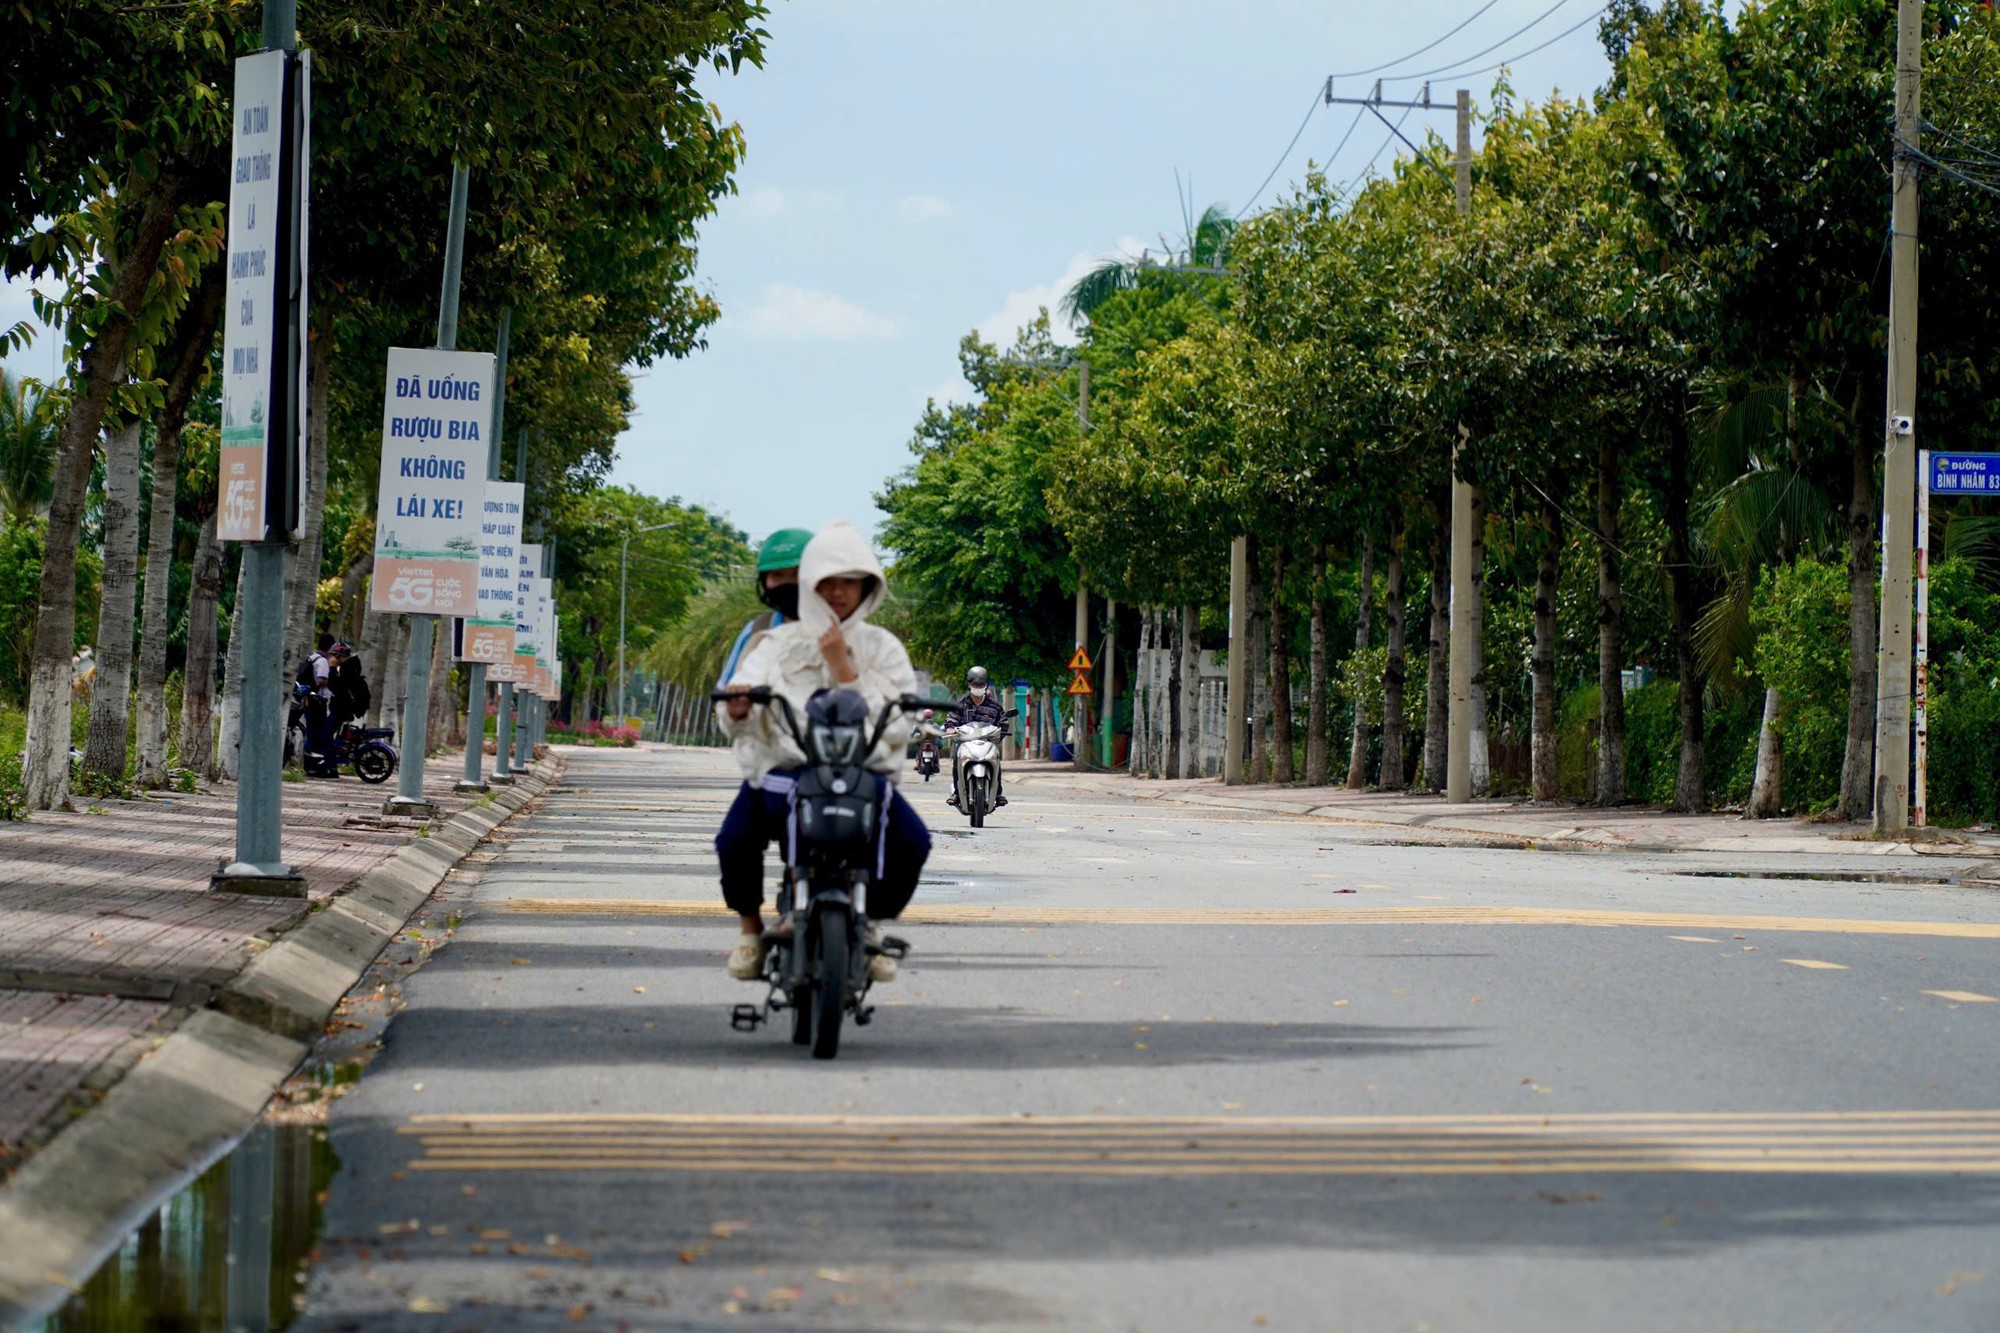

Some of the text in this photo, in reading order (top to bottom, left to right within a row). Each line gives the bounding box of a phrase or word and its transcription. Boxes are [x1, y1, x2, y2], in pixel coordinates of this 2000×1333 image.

[243, 108, 252, 135] AN
[236, 156, 251, 184] GIAO
[396, 373, 480, 401] ĐÃ UỐNG
[391, 416, 480, 442] RƯỢU BIA
[400, 455, 466, 480] KHÔNG
[1951, 459, 1986, 470] ĐƯỜNG
[1937, 472, 1957, 489] BÌNH
[1961, 472, 1986, 489] NHÂM
[396, 493, 463, 519] LÁI XE!
[398, 567, 434, 576] Viettel
[435, 577, 462, 588] CUỘC
[388, 577, 433, 606] 5G
[434, 588, 462, 599] SỐNG
[478, 589, 489, 599] IAO
[472, 639, 494, 658] 5G
